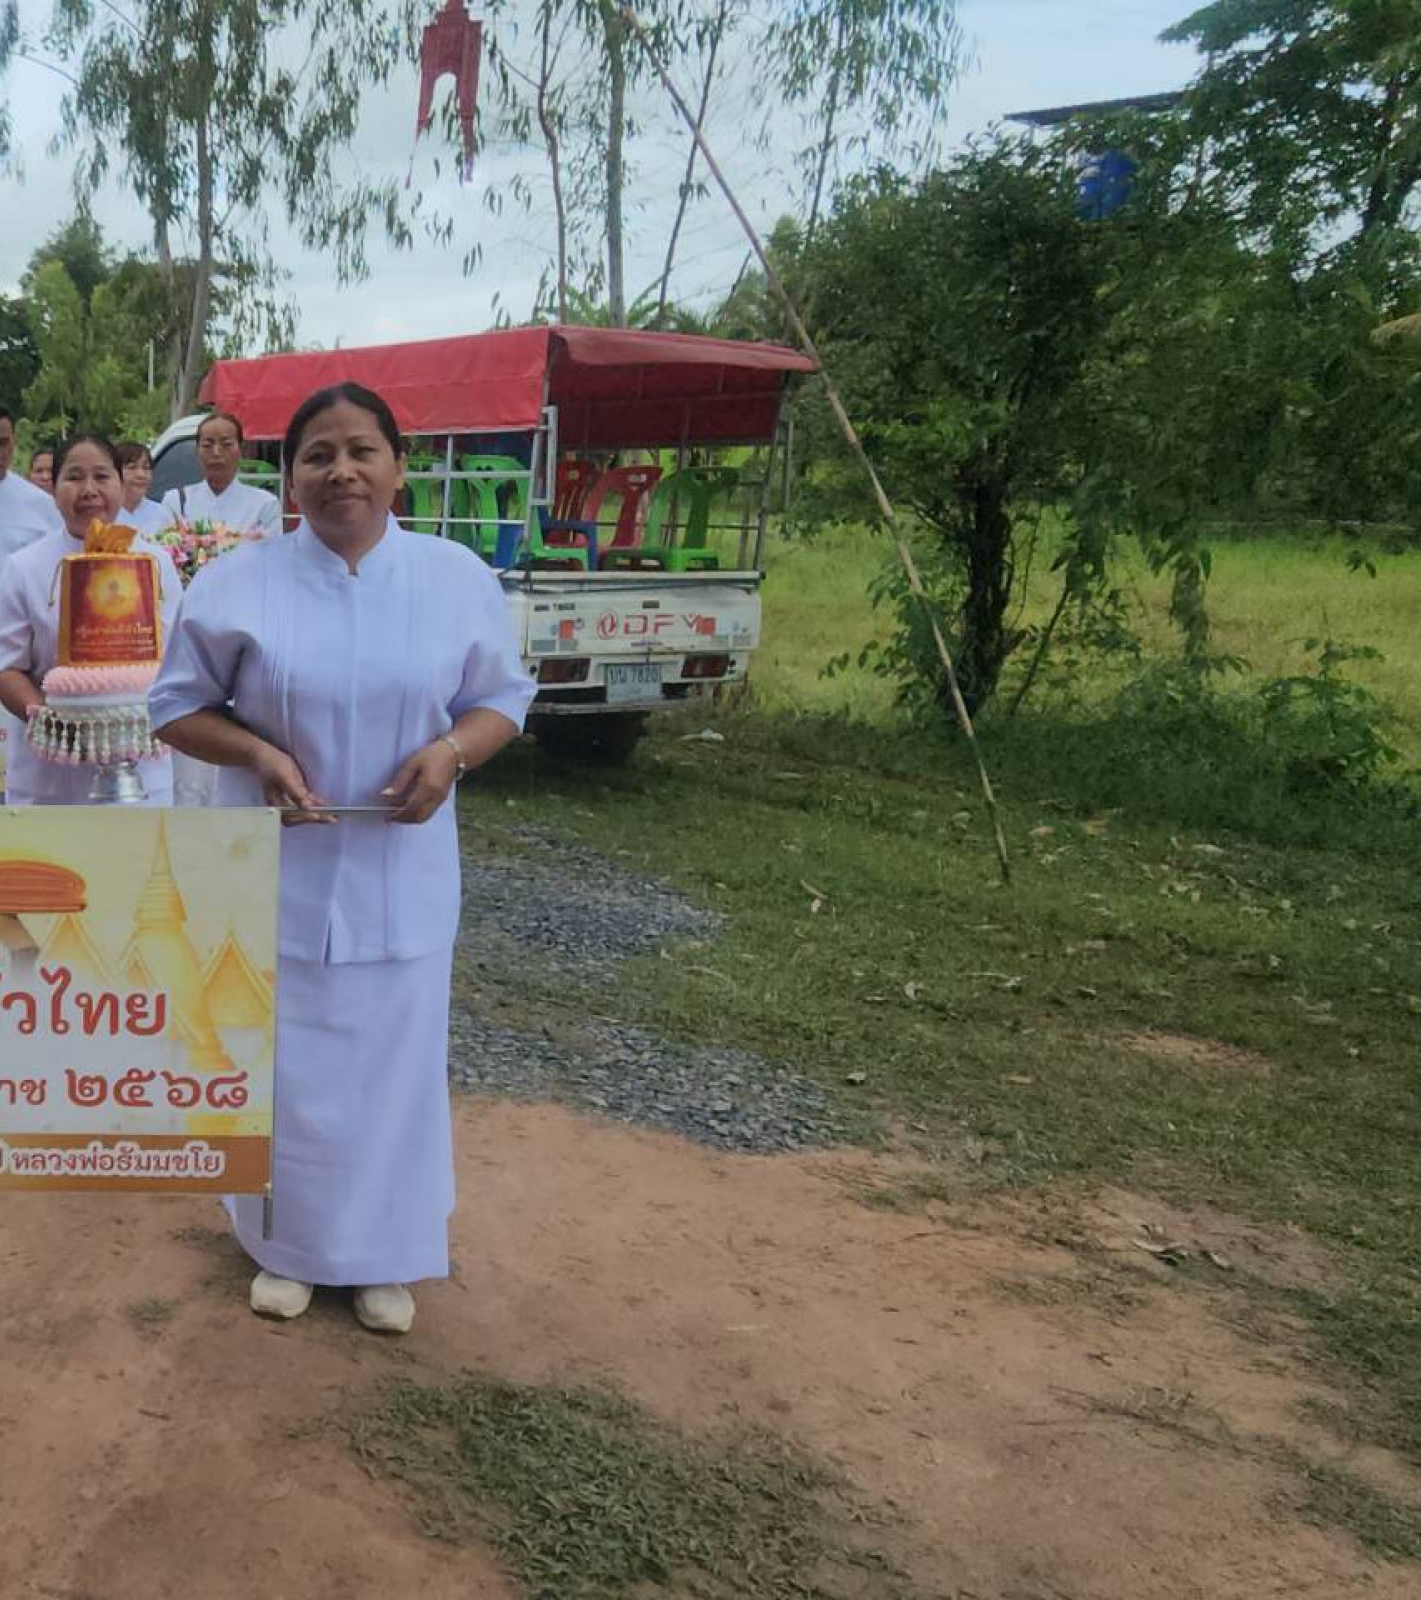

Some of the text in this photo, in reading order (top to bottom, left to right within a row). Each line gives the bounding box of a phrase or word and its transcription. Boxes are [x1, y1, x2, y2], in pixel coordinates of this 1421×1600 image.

[64, 1067, 249, 1109] ๒๕๖๘
[11, 1143, 221, 1173] หลวงพ่อธัมมชโย
